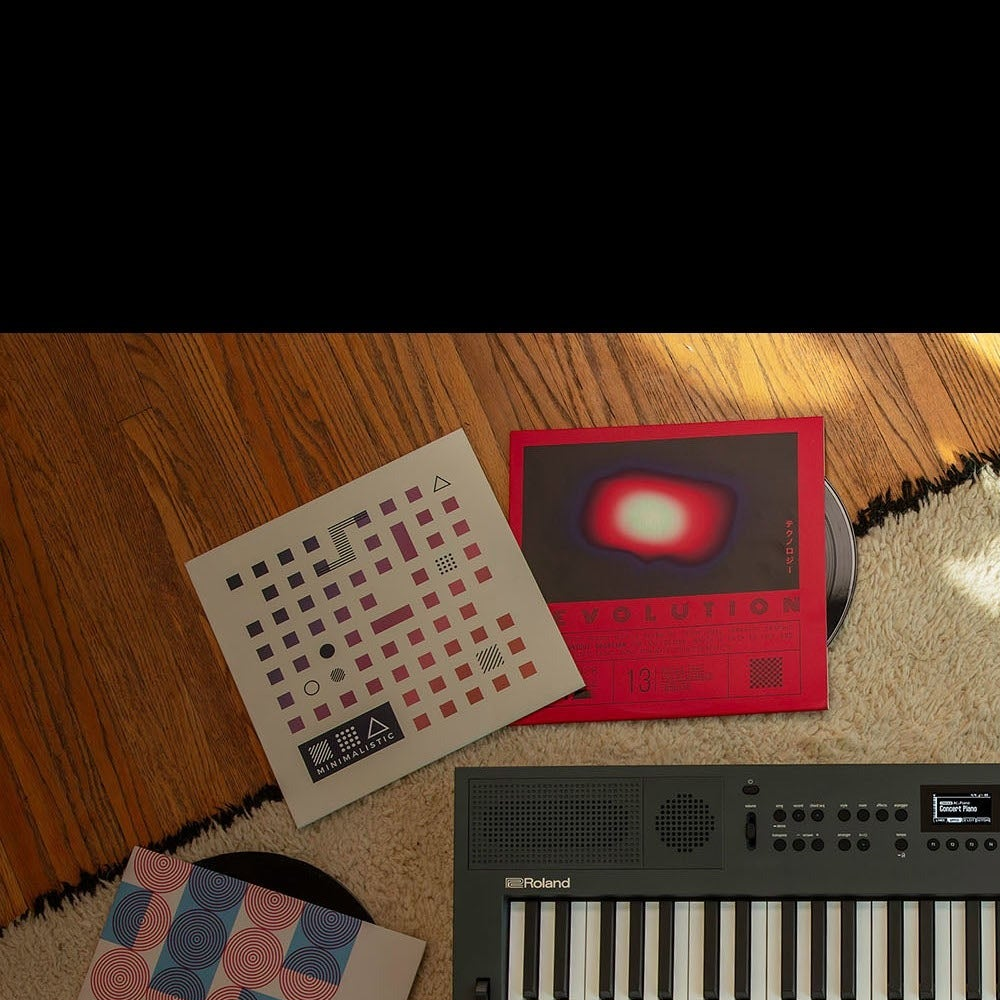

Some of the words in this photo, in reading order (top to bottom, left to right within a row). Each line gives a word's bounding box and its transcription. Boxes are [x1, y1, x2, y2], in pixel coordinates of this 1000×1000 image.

[628, 667, 651, 694] 13
[316, 732, 395, 775] MINIMALISTIC
[524, 877, 571, 889] Roland
